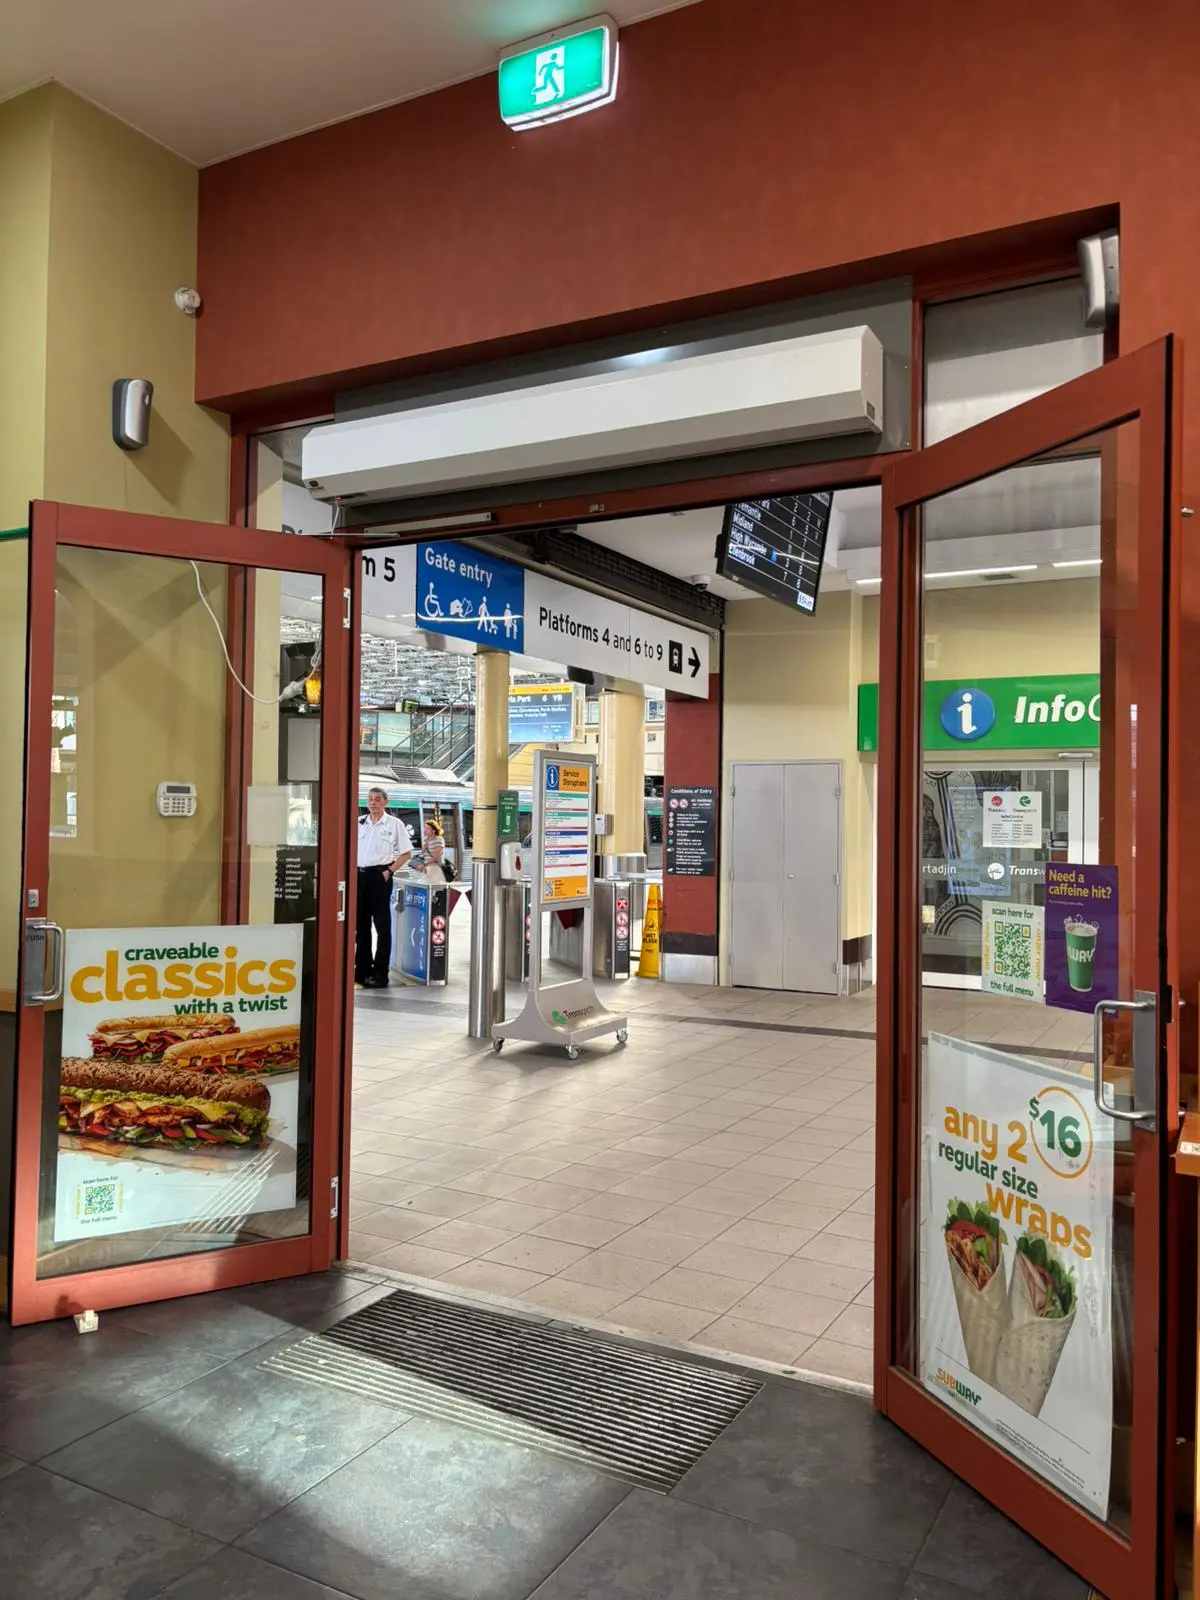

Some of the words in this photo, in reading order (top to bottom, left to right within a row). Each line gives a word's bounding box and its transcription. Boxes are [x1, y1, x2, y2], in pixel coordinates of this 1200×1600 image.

[384, 557, 395, 582] 5
[425, 547, 456, 573] Gate
[459, 562, 493, 588] entry
[539, 606, 598, 643] Platforms
[602, 628, 610, 646] 4
[613, 634, 631, 652] and
[634, 638, 641, 655] 6
[644, 640, 654, 659] to
[656, 644, 663, 661] 9
[563, 769, 580, 777] Service
[563, 778, 588, 787] Disruptions
[1048, 869, 1076, 883] Need
[1078, 873, 1085, 884] a
[1048, 883, 1089, 898] caffeine
[1091, 884, 1112, 899] hit?
[992, 907, 1006, 917] scan
[1008, 908, 1022, 919] here
[1023, 909, 1034, 920] for
[124, 942, 219, 961] craveable
[70, 946, 297, 1003] classics
[990, 980, 1001, 990] the
[1003, 982, 1014, 993] full
[1015, 986, 1034, 997] menu
[174, 998, 217, 1014] with
[222, 1000, 234, 1013] a
[239, 995, 288, 1012] twist
[944, 1106, 999, 1161] any
[1007, 1119, 1028, 1165] 2
[1029, 1096, 1082, 1159] $16
[939, 1142, 998, 1180] regular
[1002, 1166, 1038, 1199] size
[986, 1182, 1093, 1259] wraps
[936, 1367, 982, 1406] SUBWAY
